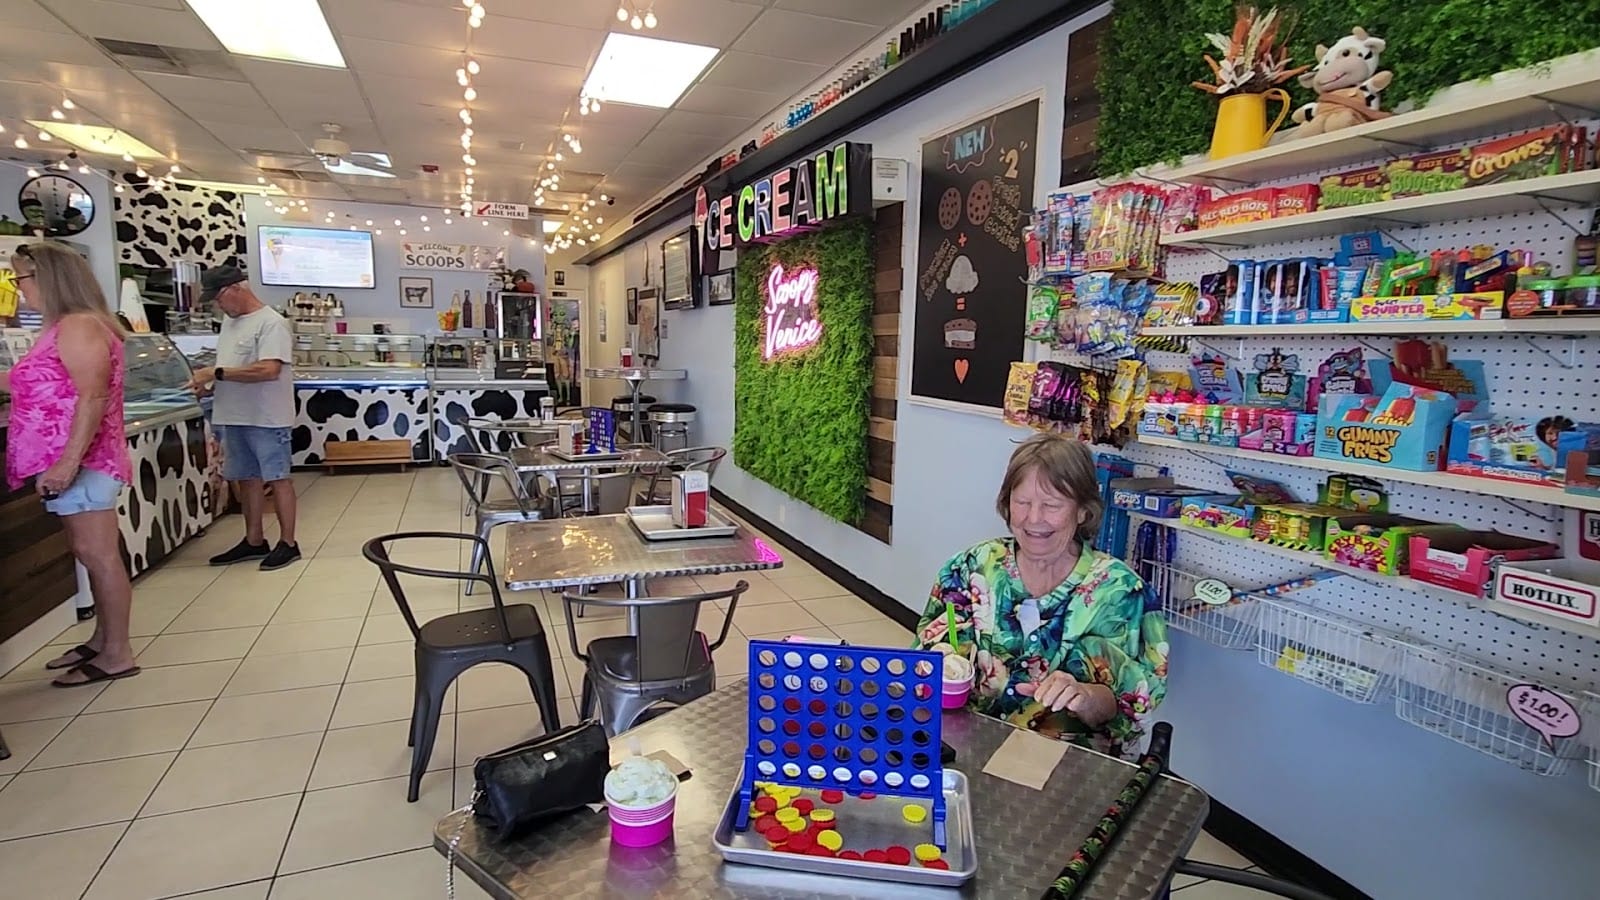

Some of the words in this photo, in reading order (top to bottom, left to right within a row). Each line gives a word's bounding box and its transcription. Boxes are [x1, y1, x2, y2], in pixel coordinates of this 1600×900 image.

[954, 126, 986, 161] NEW
[1005, 149, 1019, 179] 2
[1470, 137, 1545, 180] Crows
[738, 142, 848, 243] CREAM
[494, 203, 516, 211] FORM
[507, 210, 526, 218] HERE
[1241, 199, 1269, 212] HOTS
[418, 243, 452, 253] WELCOME
[406, 254, 465, 269] SCOOPS
[764, 264, 818, 314] Scoops
[1361, 304, 1425, 316] SQUIRTER
[764, 309, 824, 360] Venice
[1338, 426, 1400, 447] GUMMY
[1343, 441, 1392, 462] FRIES
[1512, 583, 1576, 608] HOTLIX
